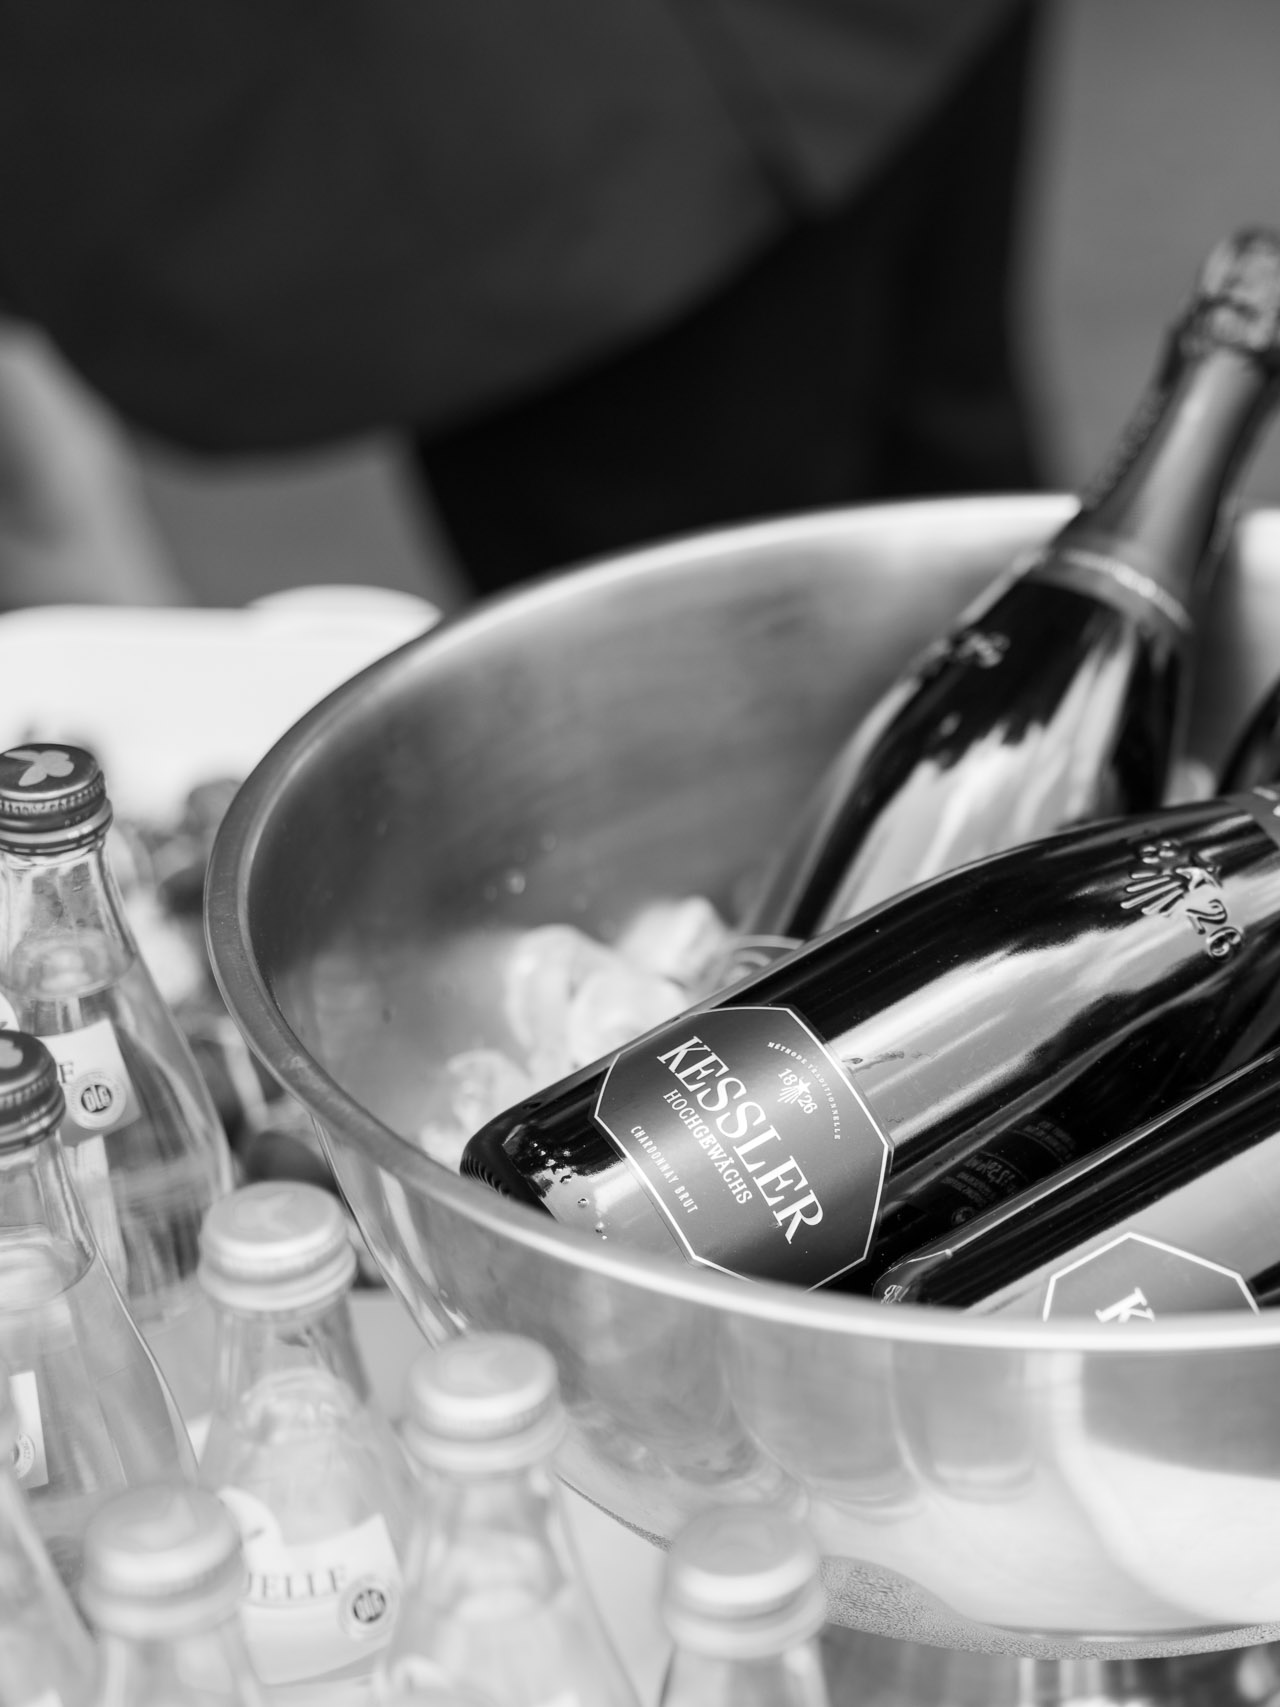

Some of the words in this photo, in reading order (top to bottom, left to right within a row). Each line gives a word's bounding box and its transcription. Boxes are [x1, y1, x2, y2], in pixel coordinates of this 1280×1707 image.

[656, 1035, 824, 1245] KESSLER
[767, 1041, 808, 1065] MÉTHODE
[807, 1063, 841, 1140] TRADITIONNELLE
[777, 1068, 798, 1086] 18
[797, 1094, 818, 1115] 26
[630, 1125, 680, 1184] CHARDONNAY
[674, 1185, 699, 1214] BRUT
[662, 1088, 753, 1204] HOCHGEWÄCHS
